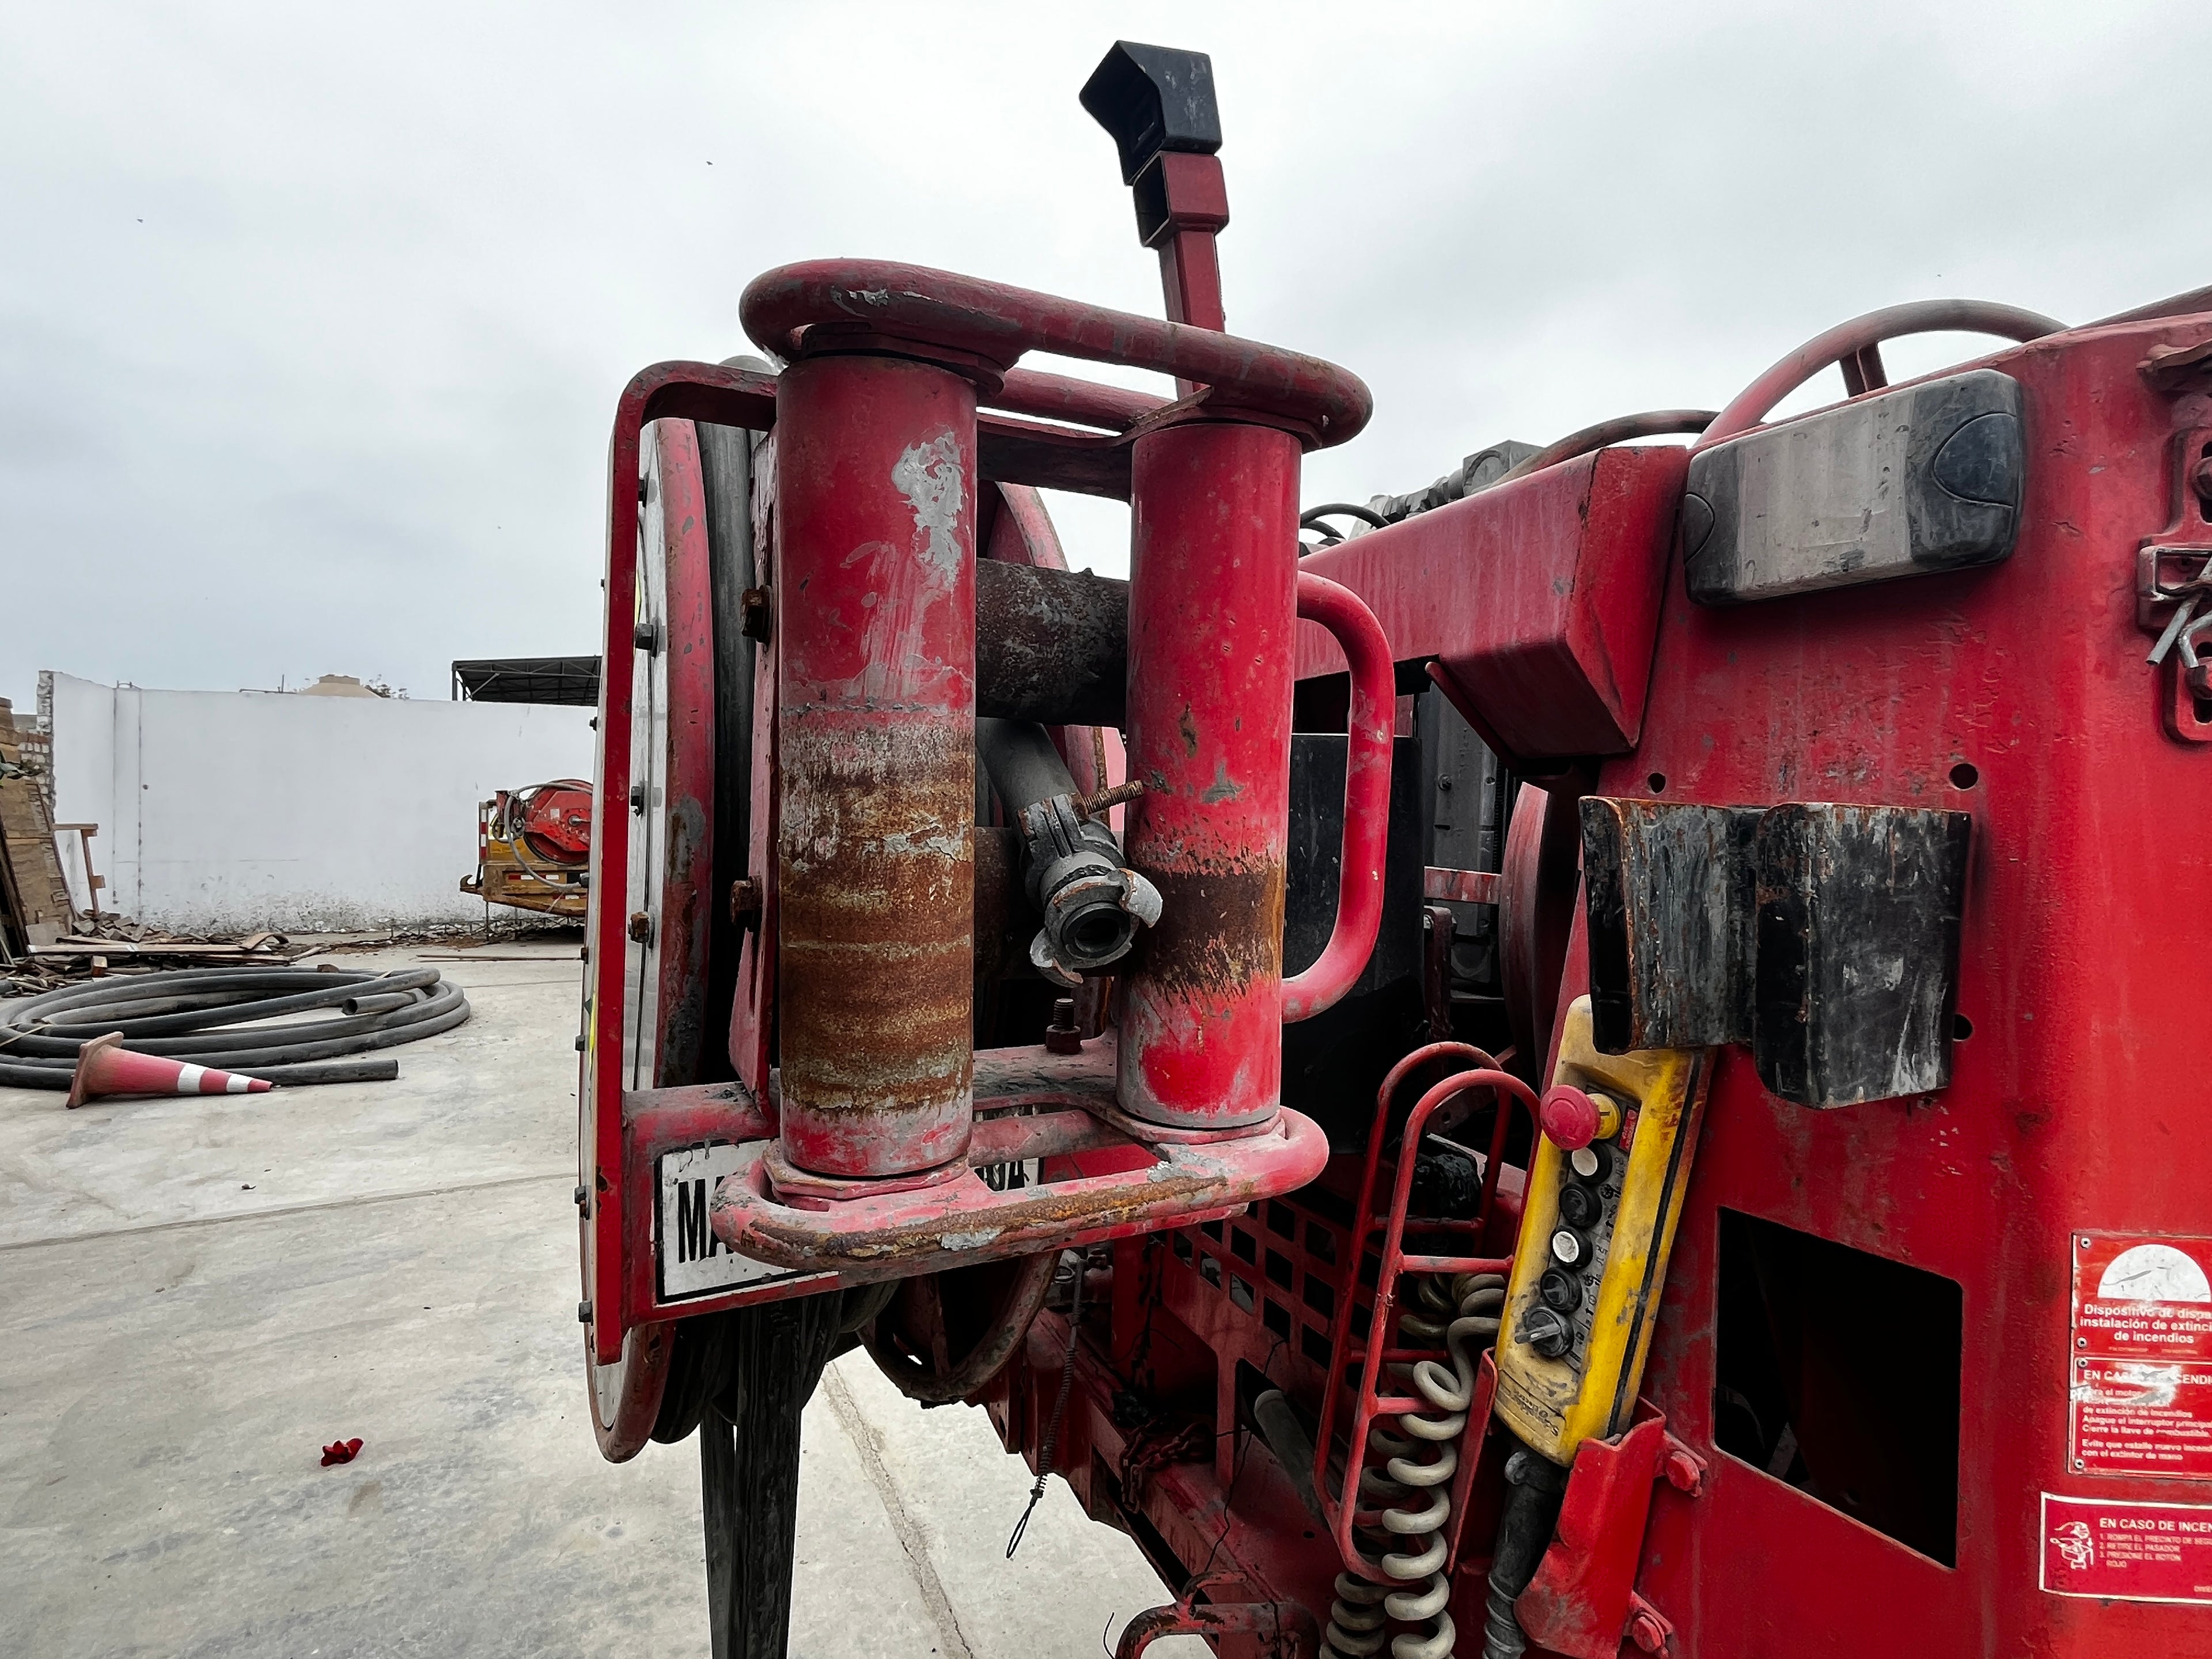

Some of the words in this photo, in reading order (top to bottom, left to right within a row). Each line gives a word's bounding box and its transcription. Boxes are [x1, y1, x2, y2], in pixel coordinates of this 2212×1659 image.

[2152, 1319, 2167, 1330] de
[2113, 1331, 2129, 1341] de
[2084, 1370, 2101, 1380] EN
[2100, 1517, 2116, 1528] EN
[2119, 1518, 2156, 1530] CASO
[2158, 1520, 2176, 1531] DE
